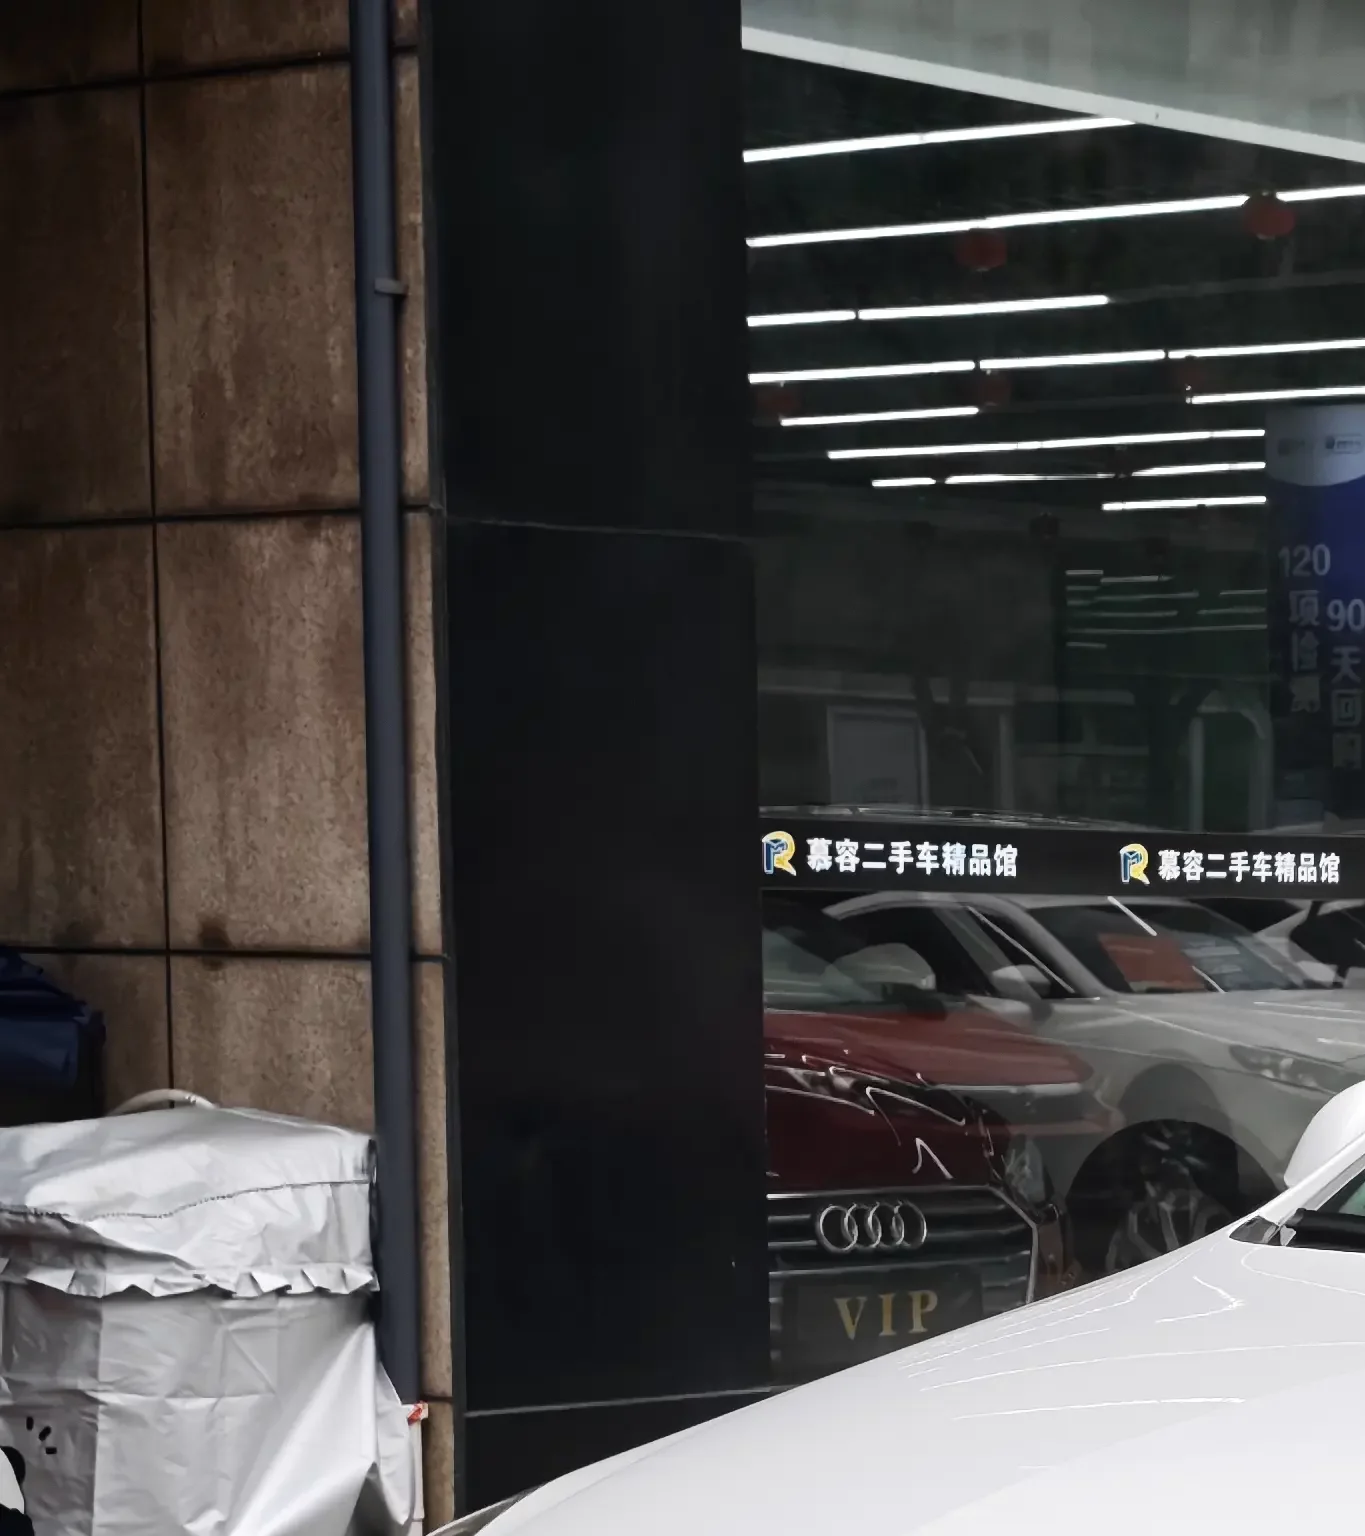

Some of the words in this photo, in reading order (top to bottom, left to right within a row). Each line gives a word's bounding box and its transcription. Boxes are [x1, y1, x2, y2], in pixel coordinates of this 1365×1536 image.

[806, 837, 1019, 878] 慕容二手车精品馆
[1157, 849, 1341, 884] 慕容二手车精品馆
[834, 1289, 938, 1340] VIP
